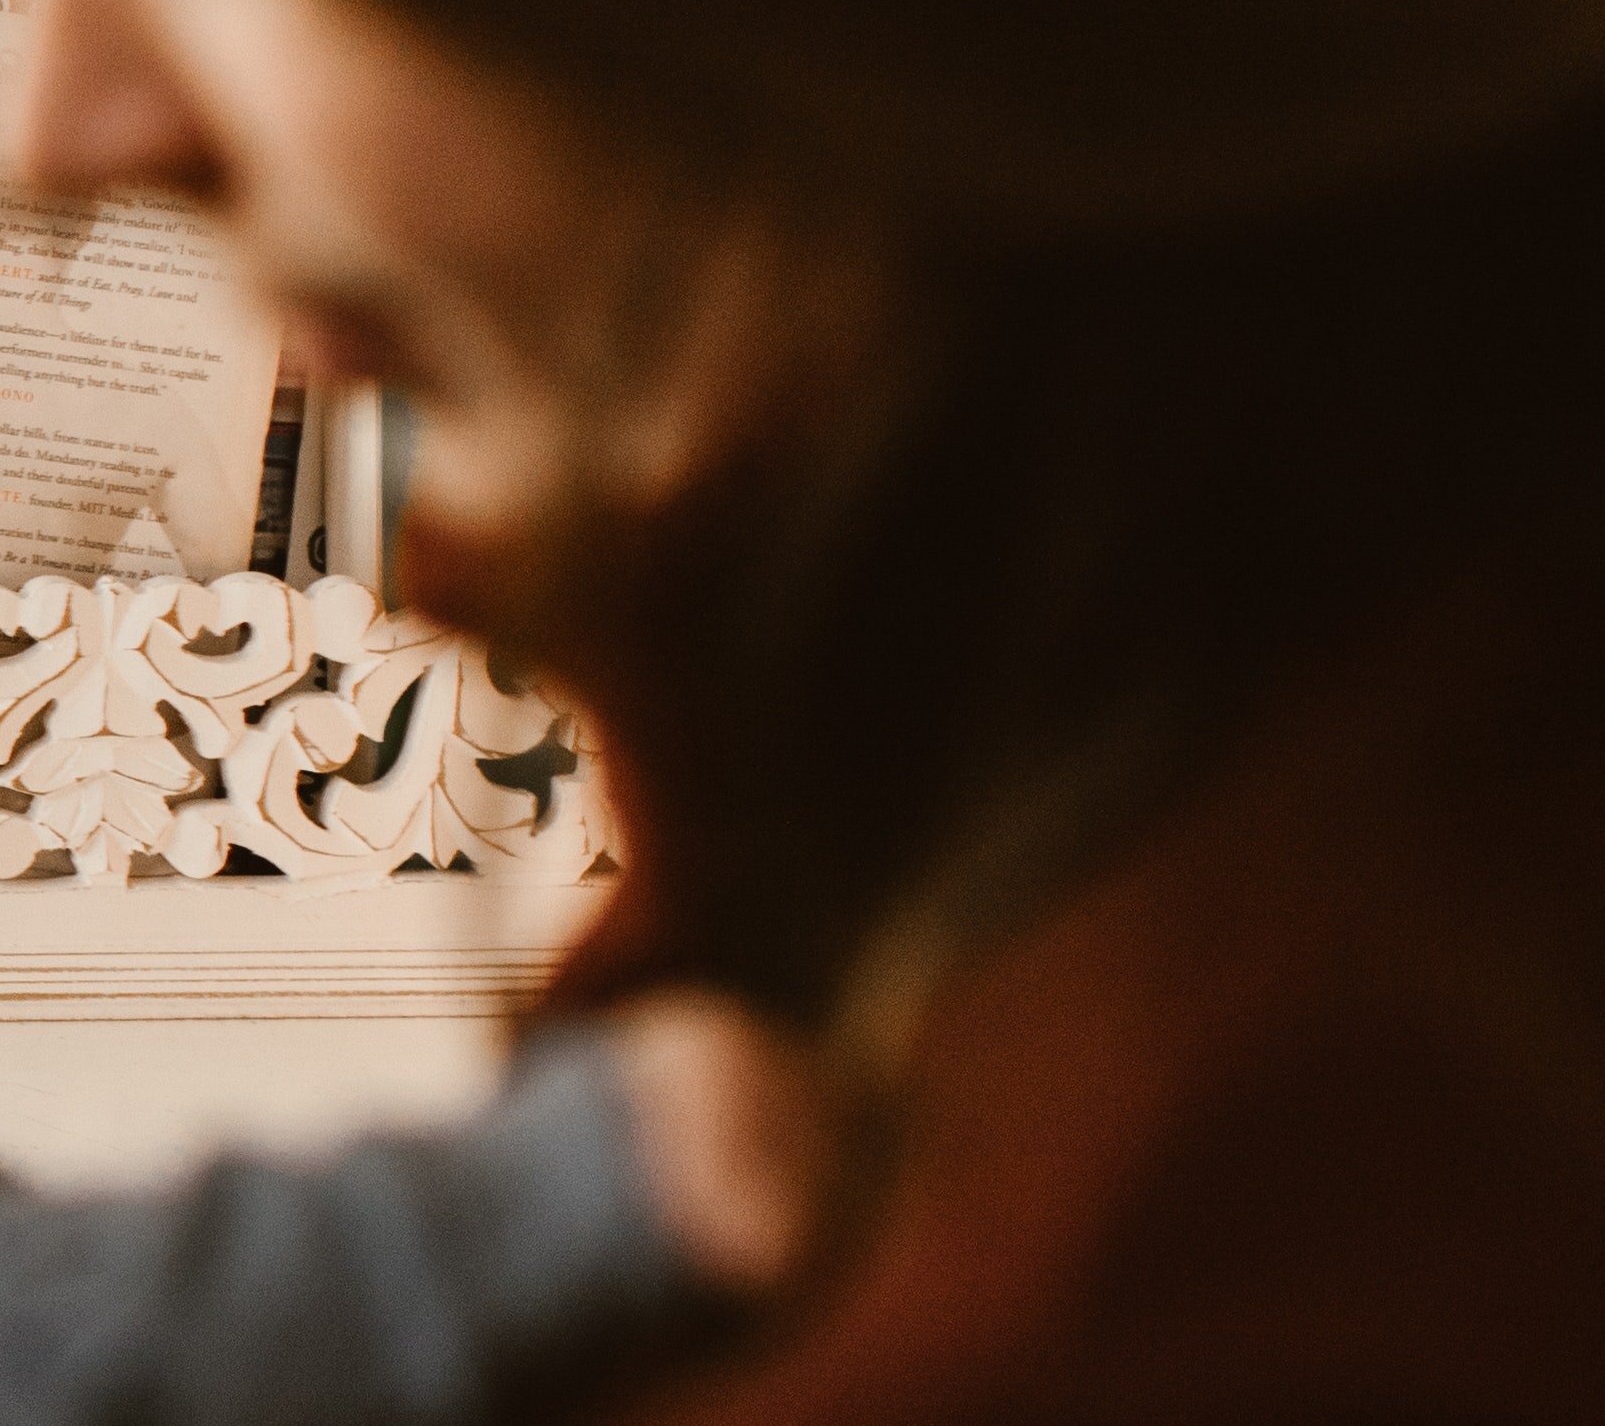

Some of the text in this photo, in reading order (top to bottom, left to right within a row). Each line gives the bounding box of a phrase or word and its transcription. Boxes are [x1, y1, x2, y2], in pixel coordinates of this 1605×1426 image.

[0, 194, 27, 211] How
[123, 213, 161, 230] endure
[22, 223, 46, 236] your
[50, 244, 78, 261] book
[83, 250, 105, 264] will
[107, 253, 134, 269] show
[153, 259, 169, 273] all
[171, 261, 195, 277] how
[37, 271, 75, 286] author
[175, 290, 198, 304] and
[57, 291, 92, 311] Things
[67, 329, 106, 347] lifeline
[111, 335, 127, 350] for
[129, 338, 158, 354] them
[160, 344, 183, 357] and
[184, 345, 201, 360] for
[33, 369, 84, 389] anything
[87, 373, 106, 389] but
[109, 377, 126, 391] the
[55, 352, 107, 368] surrender
[168, 367, 209, 382] capable
[52, 428, 79, 445] from
[35, 447, 96, 472] Mandatory
[100, 459, 140, 478] reading
[2, 465, 24, 479] and
[26, 468, 52, 483] their
[54, 471, 104, 490] doubtful
[77, 499, 106, 516] MIT
[108, 503, 143, 521] Media
[36, 528, 60, 544] how
[77, 535, 115, 554] change
[117, 540, 145, 556] their
[32, 553, 73, 571] Woman
